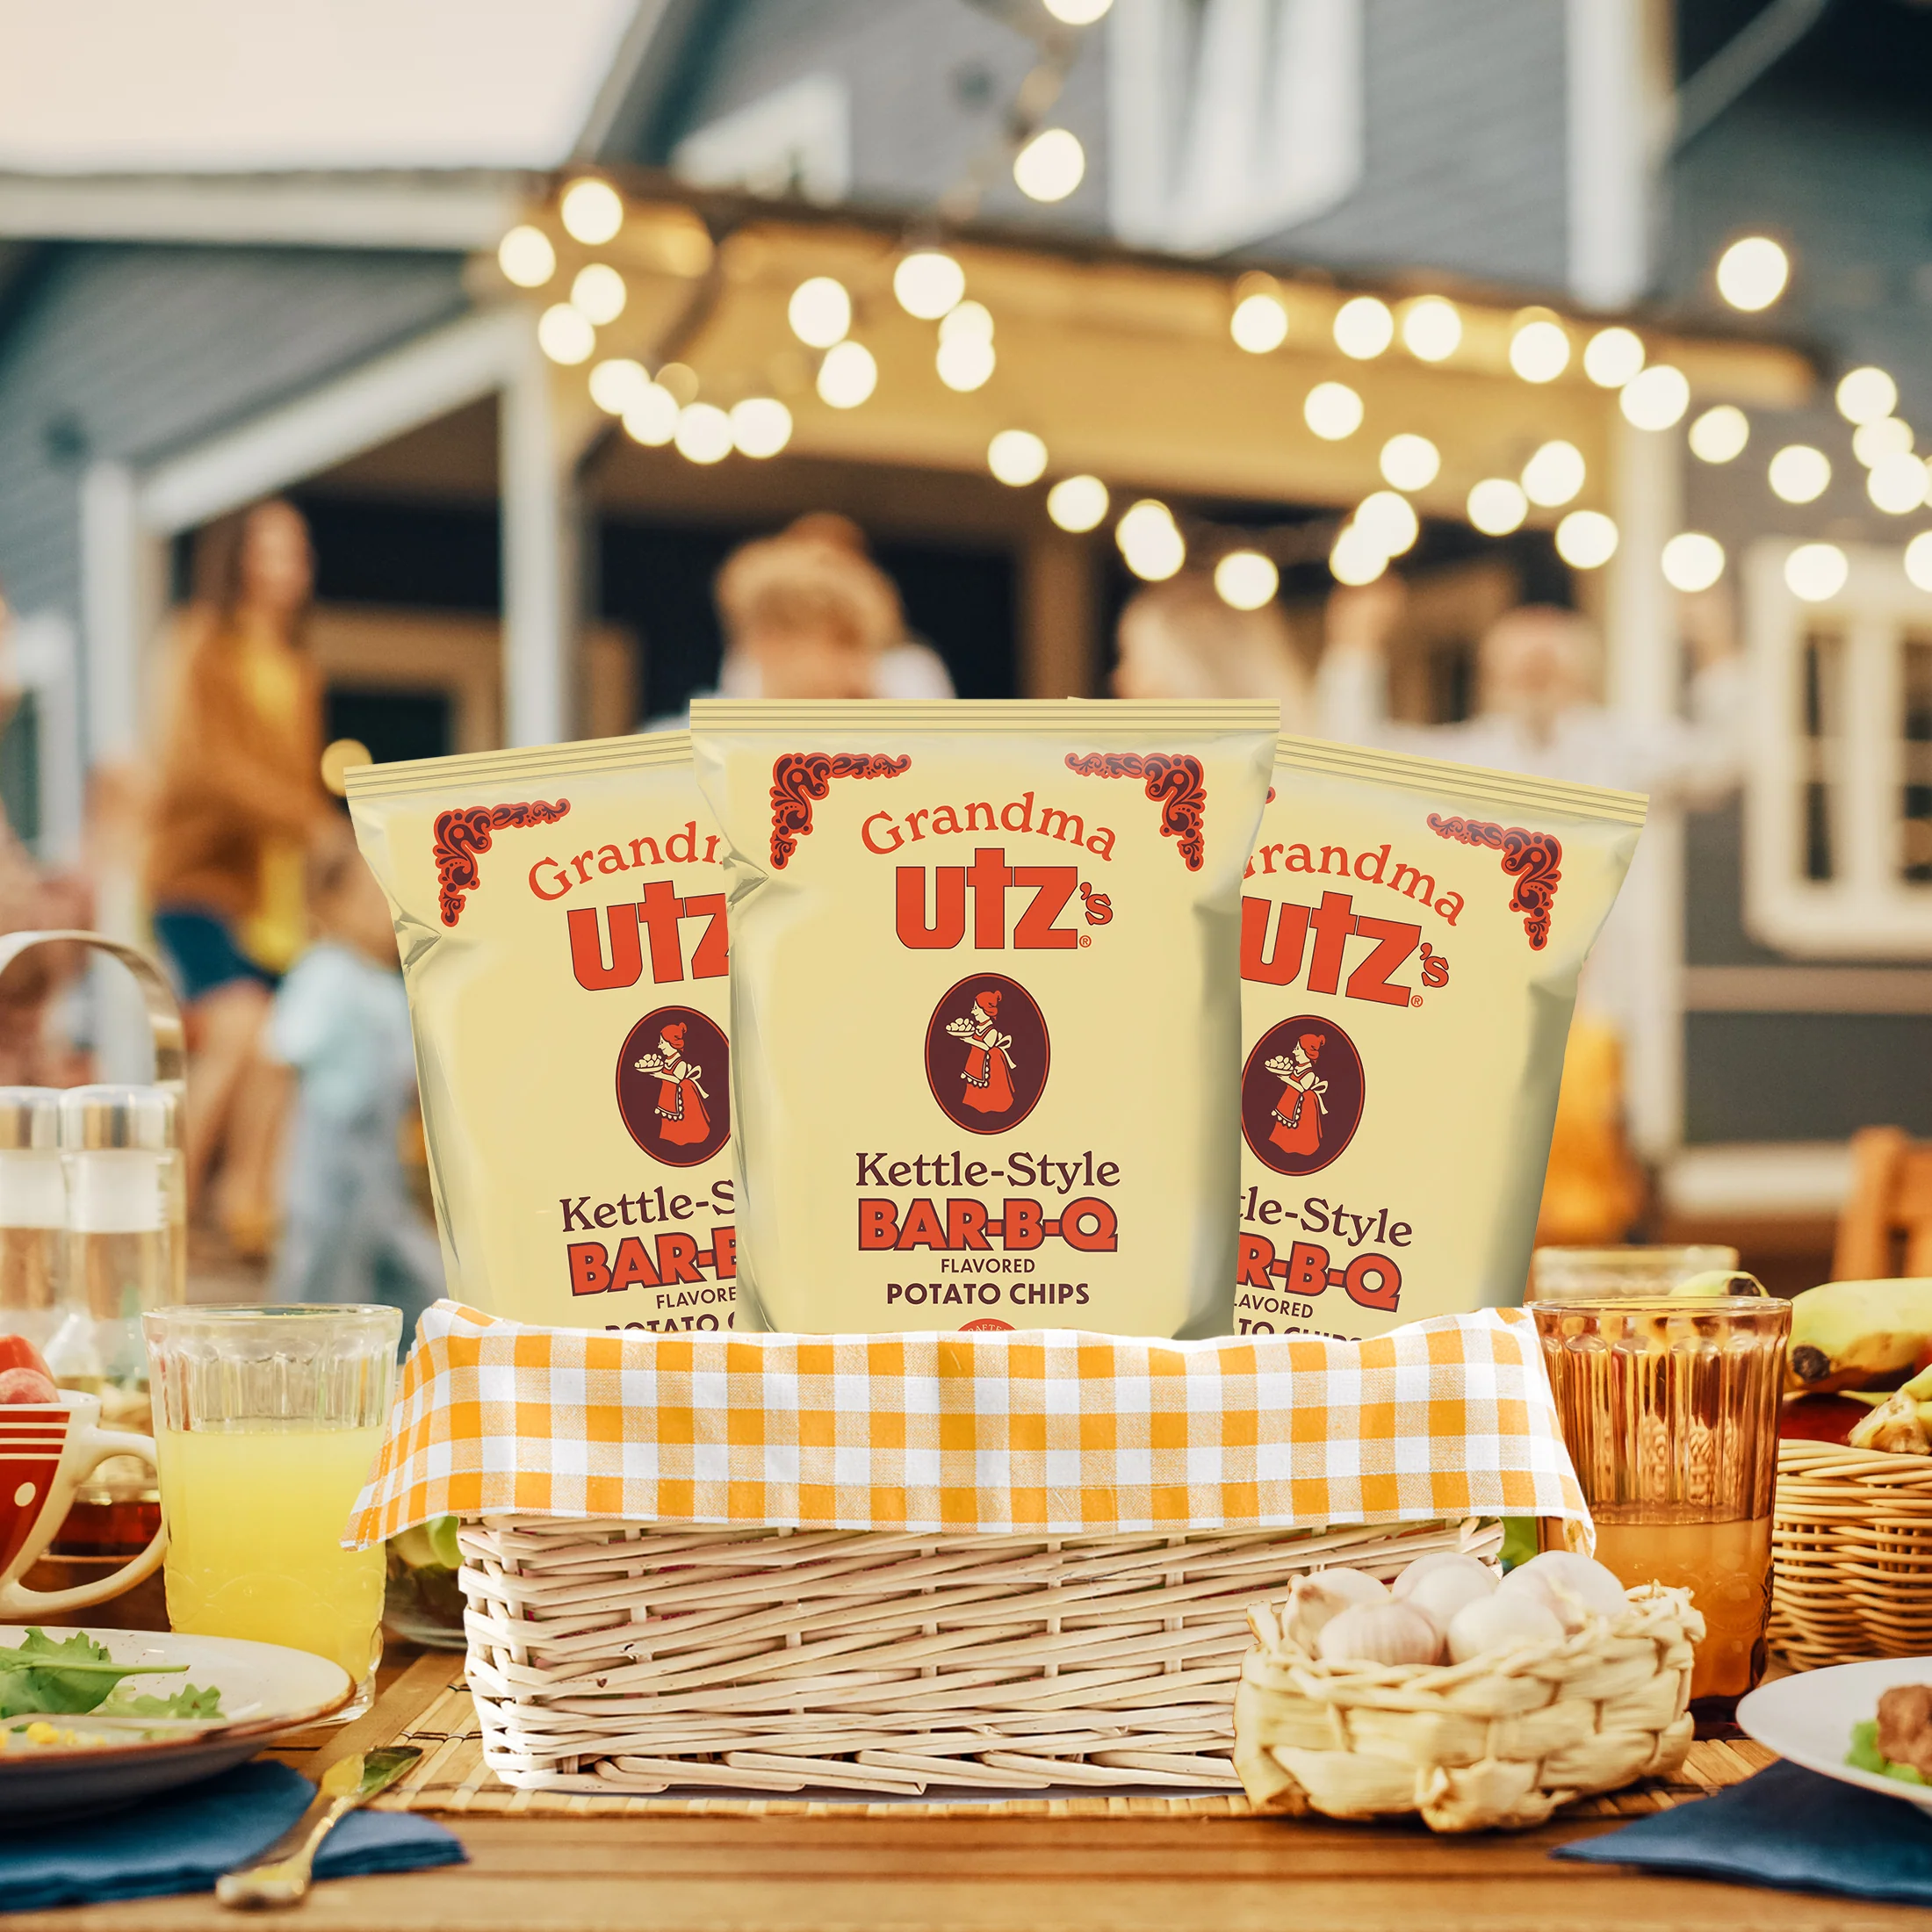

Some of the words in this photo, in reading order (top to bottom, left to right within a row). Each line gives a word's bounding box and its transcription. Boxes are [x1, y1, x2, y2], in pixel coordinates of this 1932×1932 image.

[861, 791, 1117, 861] Grandma
[529, 821, 723, 901] Grand
[855, 1150, 1121, 1194] Kettle-Style
[858, 1196, 1119, 1252] BAR-B-Q
[941, 1258, 1036, 1274] FLAVORED
[656, 1286, 737, 1309] FLAVORE
[886, 1283, 1001, 1305] POTATO
[1009, 1283, 1090, 1305] CHIPS
[1234, 1294, 1314, 1318] AVORED
